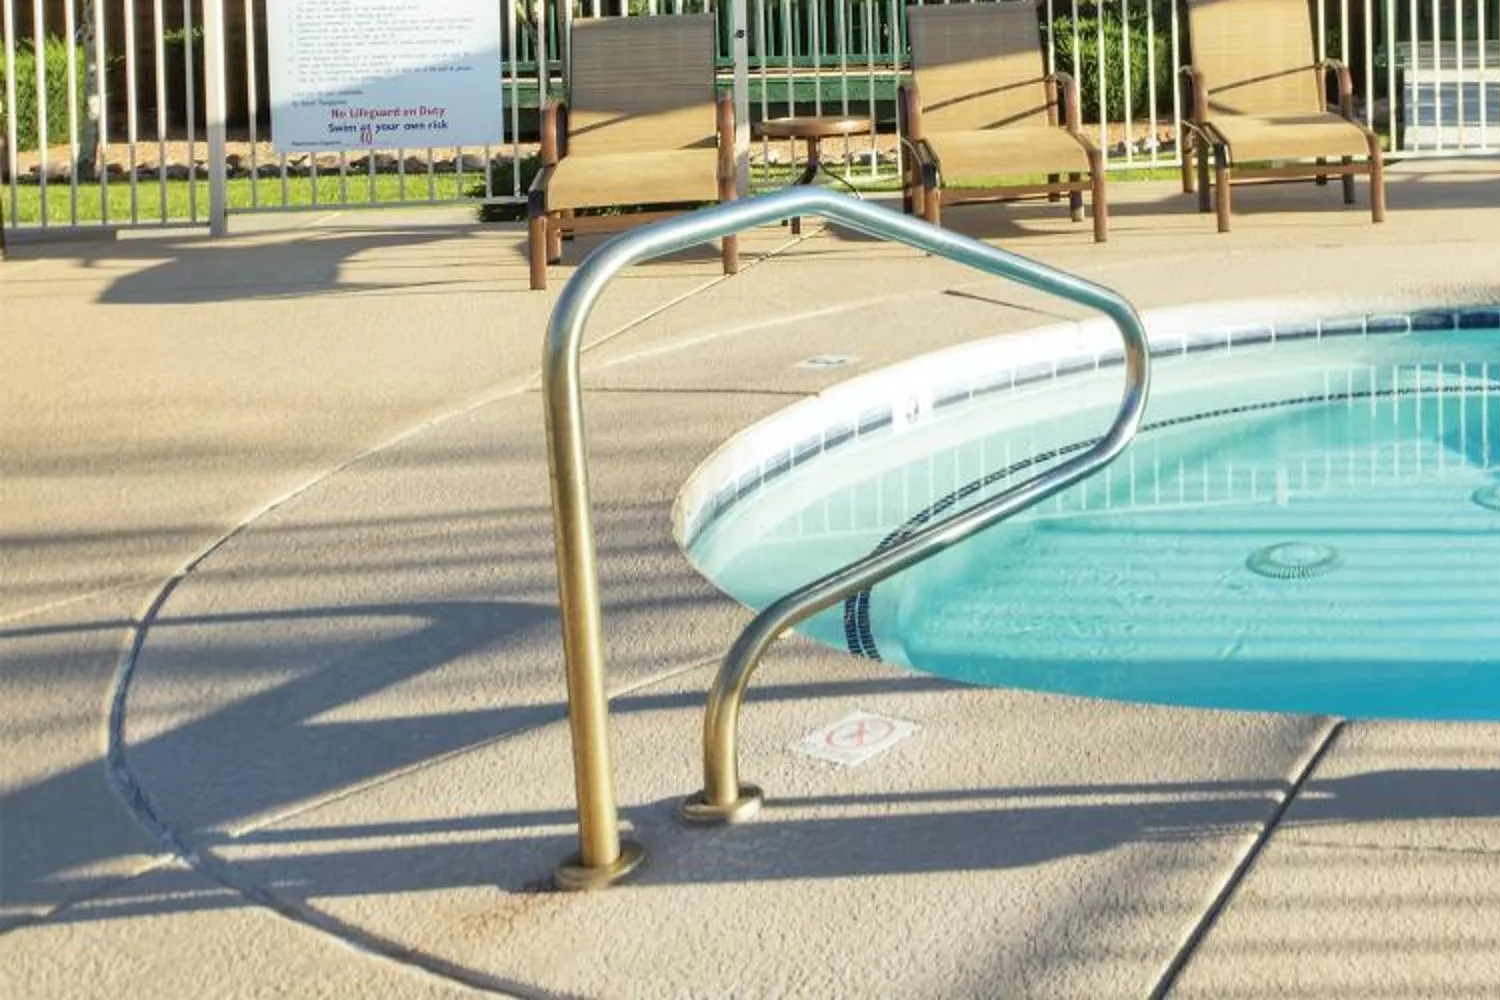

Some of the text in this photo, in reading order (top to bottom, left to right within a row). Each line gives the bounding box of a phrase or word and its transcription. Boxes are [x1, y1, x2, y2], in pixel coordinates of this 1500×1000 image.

[331, 105, 445, 120] No Lifeguard on Duty
[328, 119, 449, 134] Swim at your own risk
